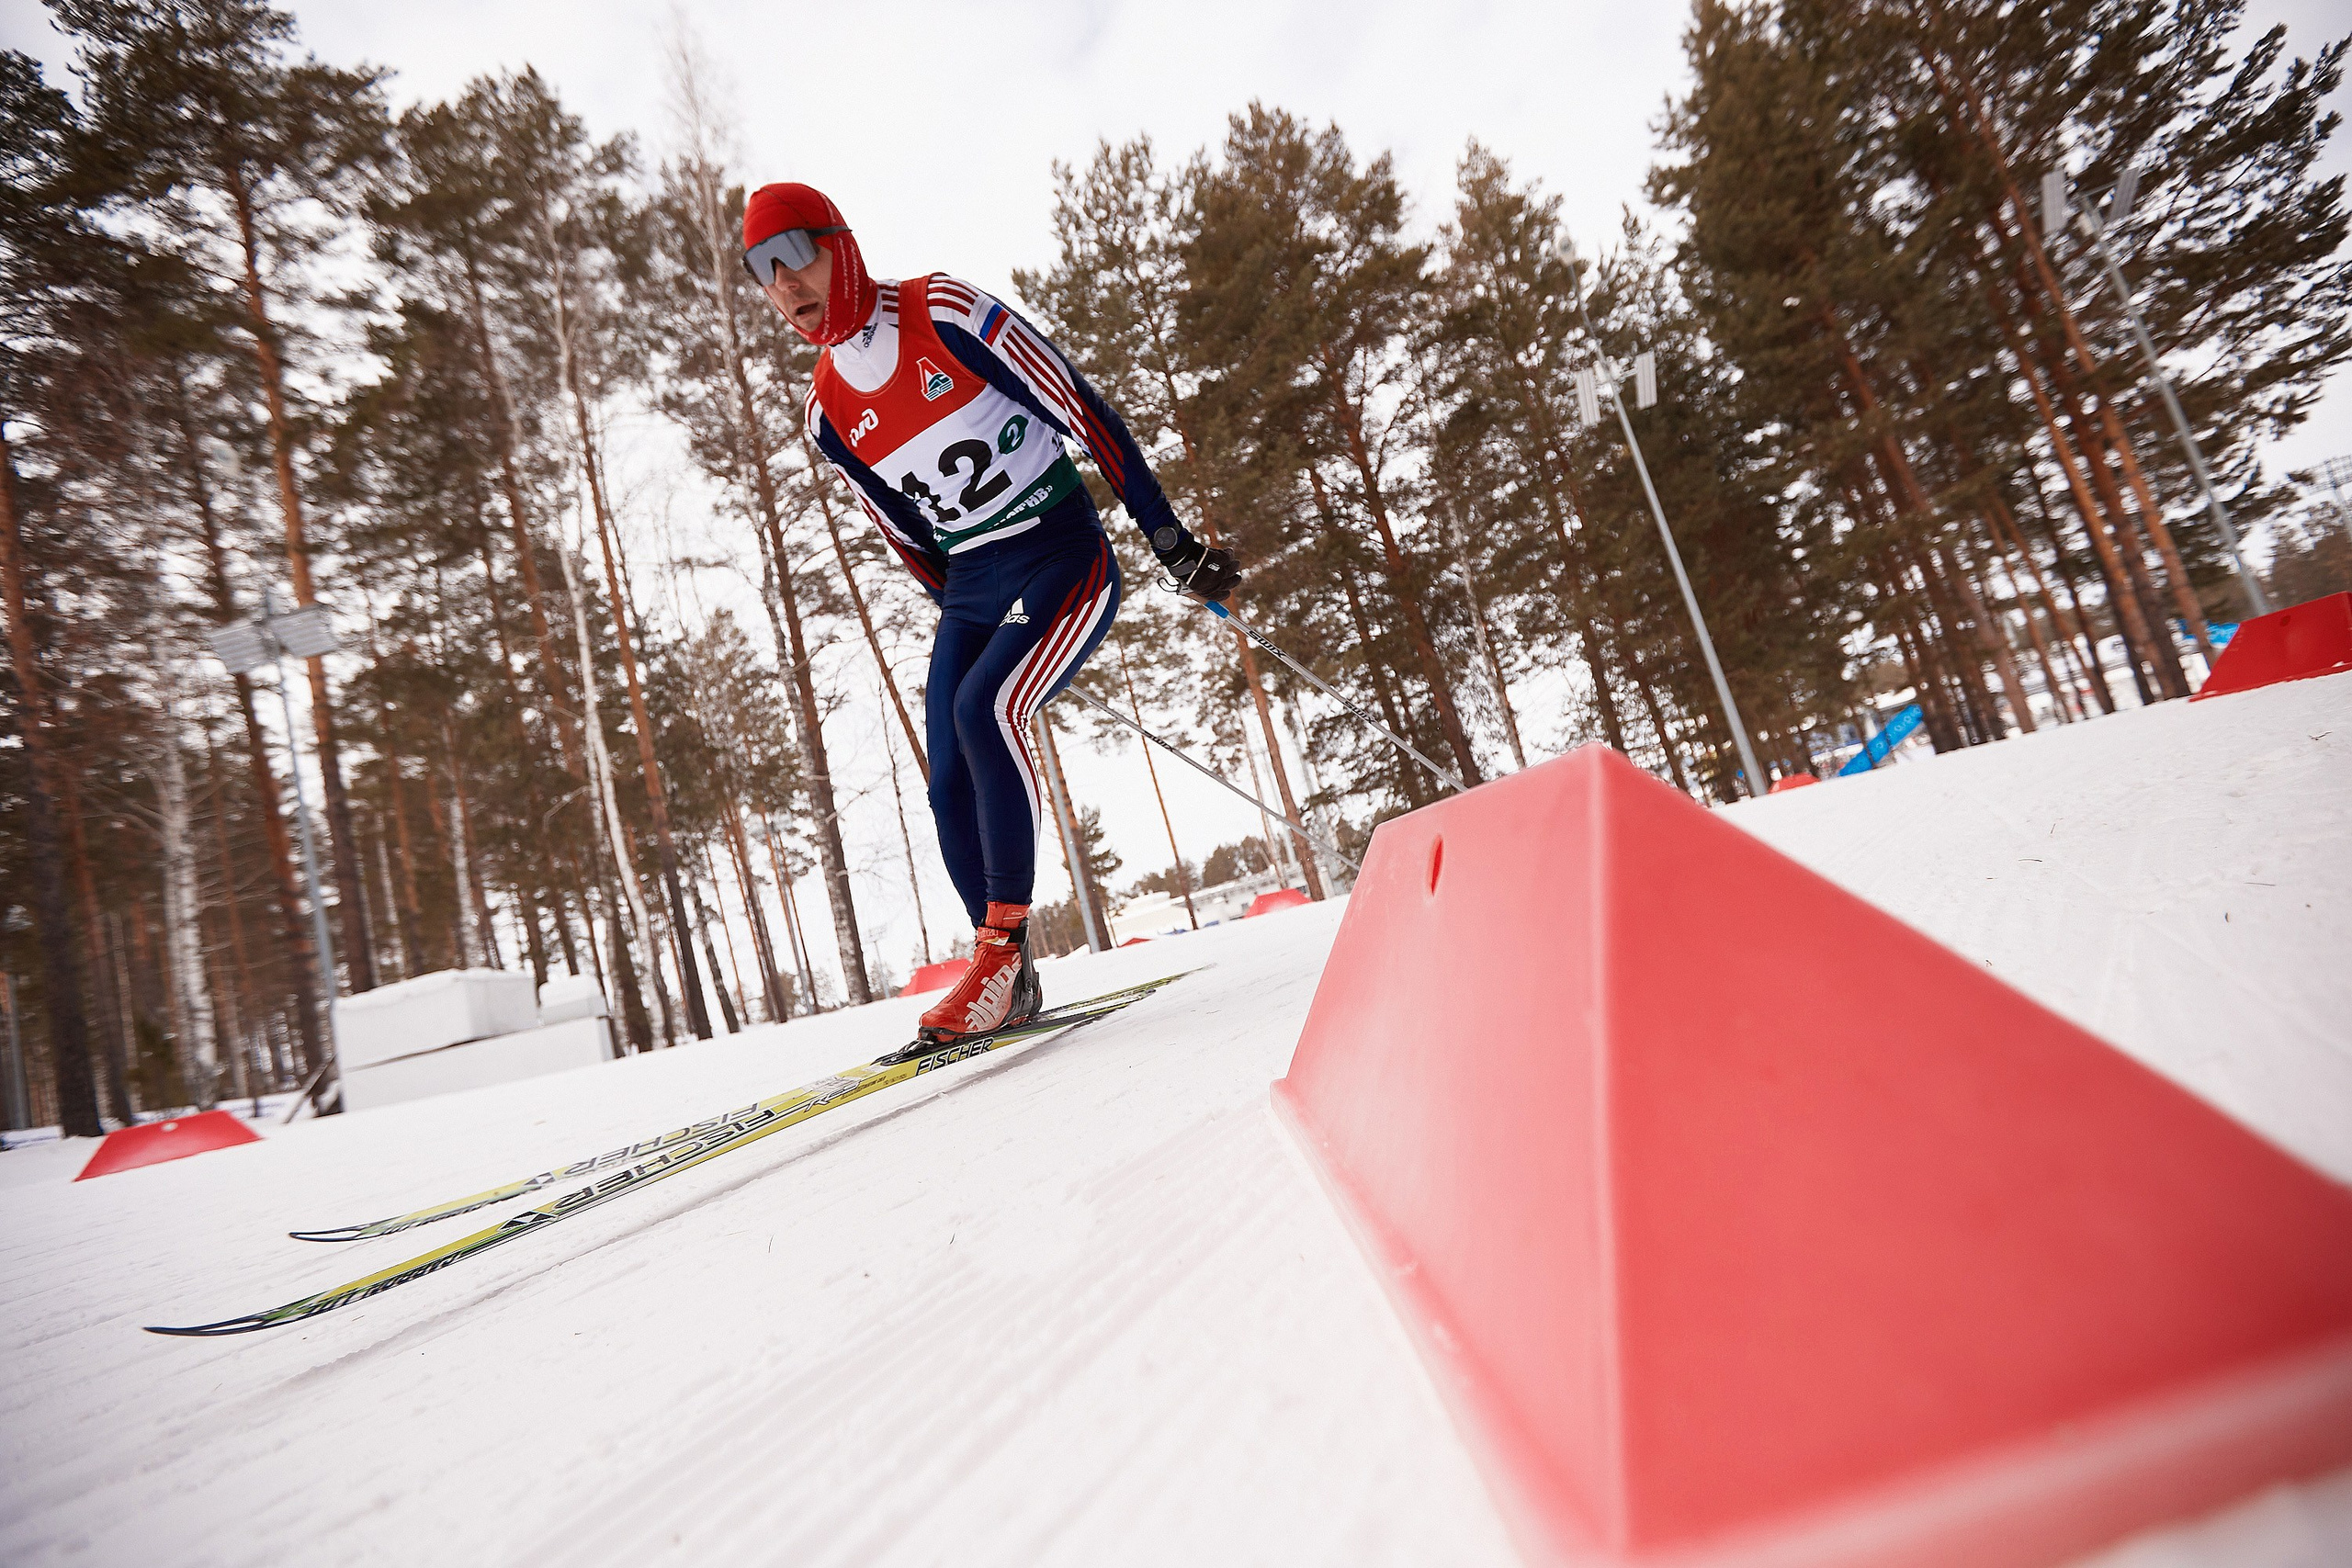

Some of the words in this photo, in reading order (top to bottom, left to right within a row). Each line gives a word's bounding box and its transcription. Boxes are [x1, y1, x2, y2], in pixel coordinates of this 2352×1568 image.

[1246, 629, 1287, 659] SWIX
[1343, 700, 1376, 725] SWIX
[915, 1037, 995, 1077] FISCHER
[563, 1102, 757, 1176] FISCHER
[553, 1109, 775, 1210] FISCHER
